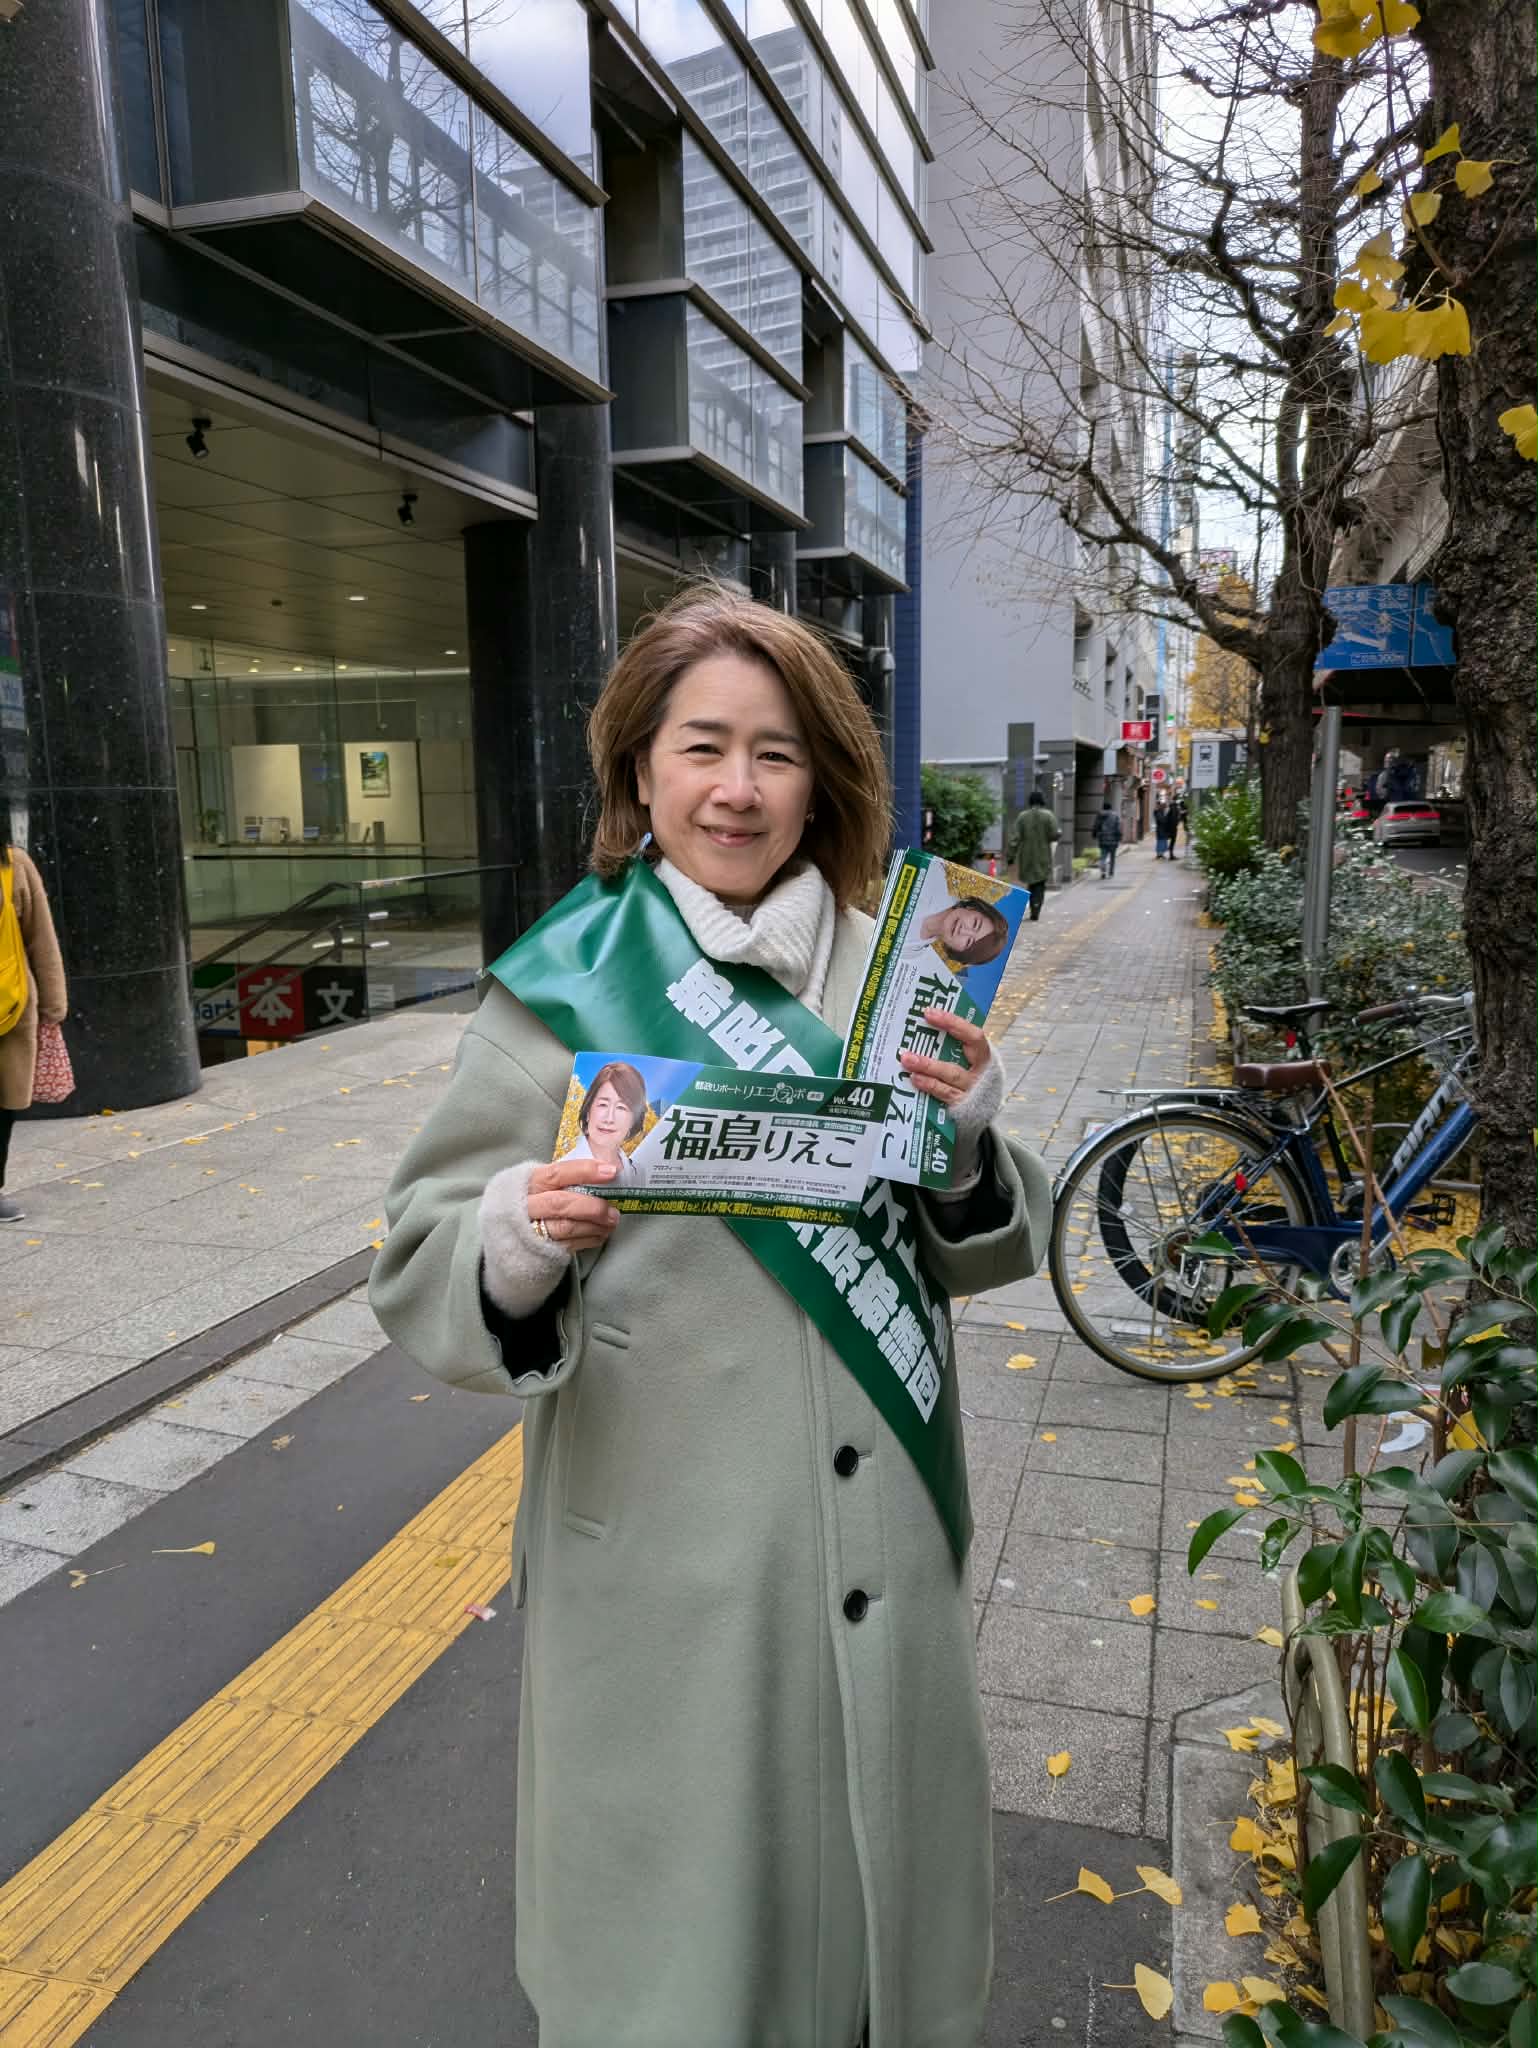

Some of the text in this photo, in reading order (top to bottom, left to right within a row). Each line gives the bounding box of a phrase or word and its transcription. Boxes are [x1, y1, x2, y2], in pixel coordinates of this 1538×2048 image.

[194, 998, 235, 1021] art
[247, 976, 293, 1027] 本
[847, 1086, 875, 1108] 40
[659, 1106, 858, 1171] 福島りえこ
[1391, 1072, 1457, 1173] GIAN
[931, 1146, 948, 1174] 40
